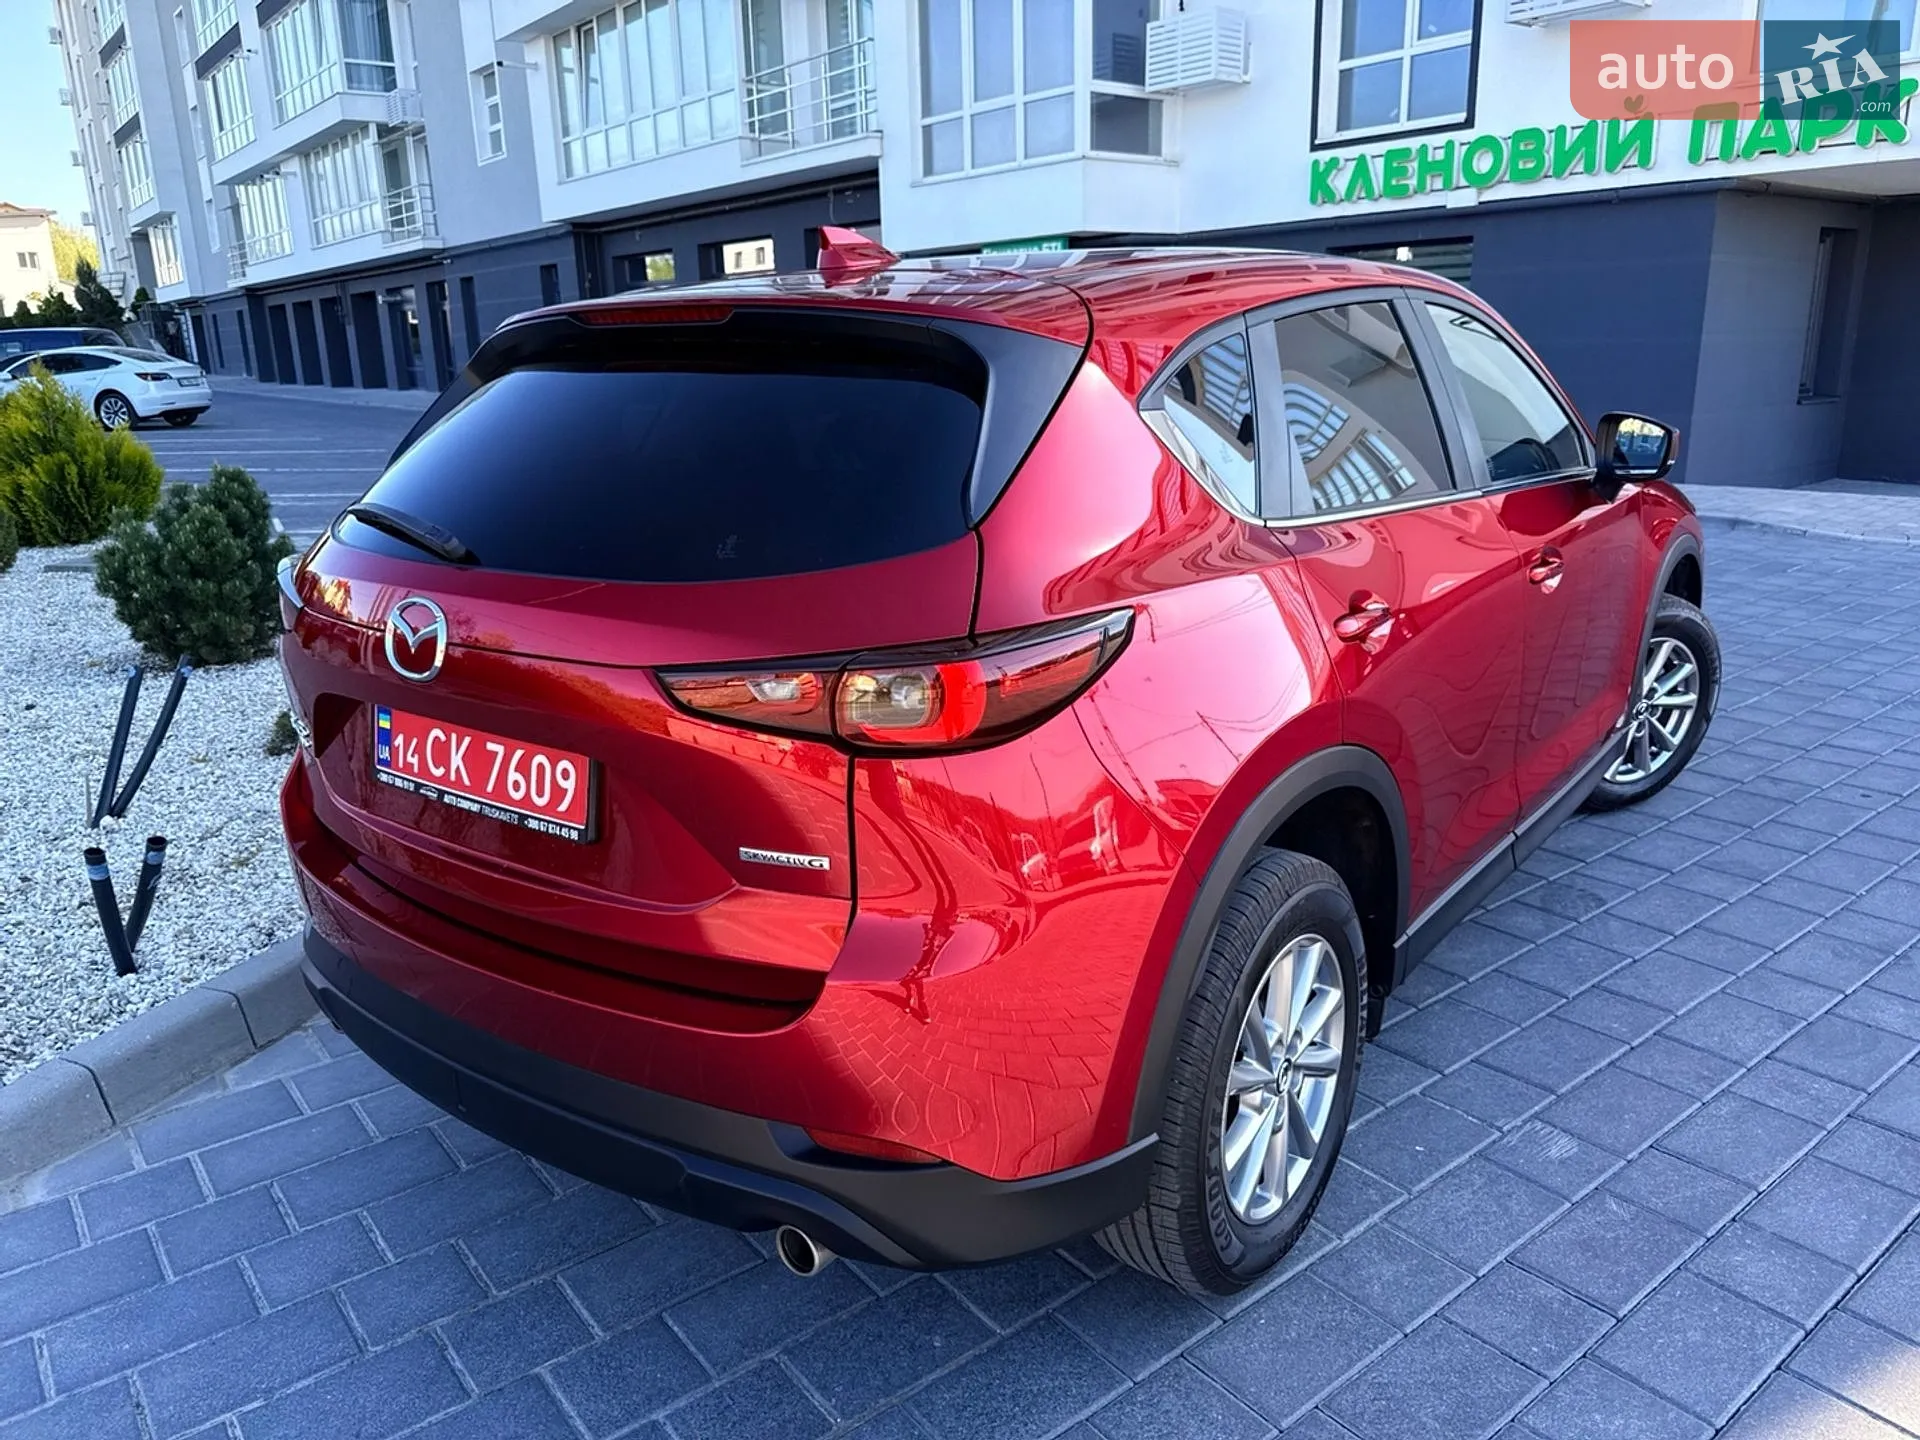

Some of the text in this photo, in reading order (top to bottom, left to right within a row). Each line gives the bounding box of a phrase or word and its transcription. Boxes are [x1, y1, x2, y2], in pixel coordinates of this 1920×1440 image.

[1310, 77, 1919, 205] КЛЕНОВИЙ ПАРК
[378, 743, 390, 761] UA
[485, 741, 576, 813] 7609
